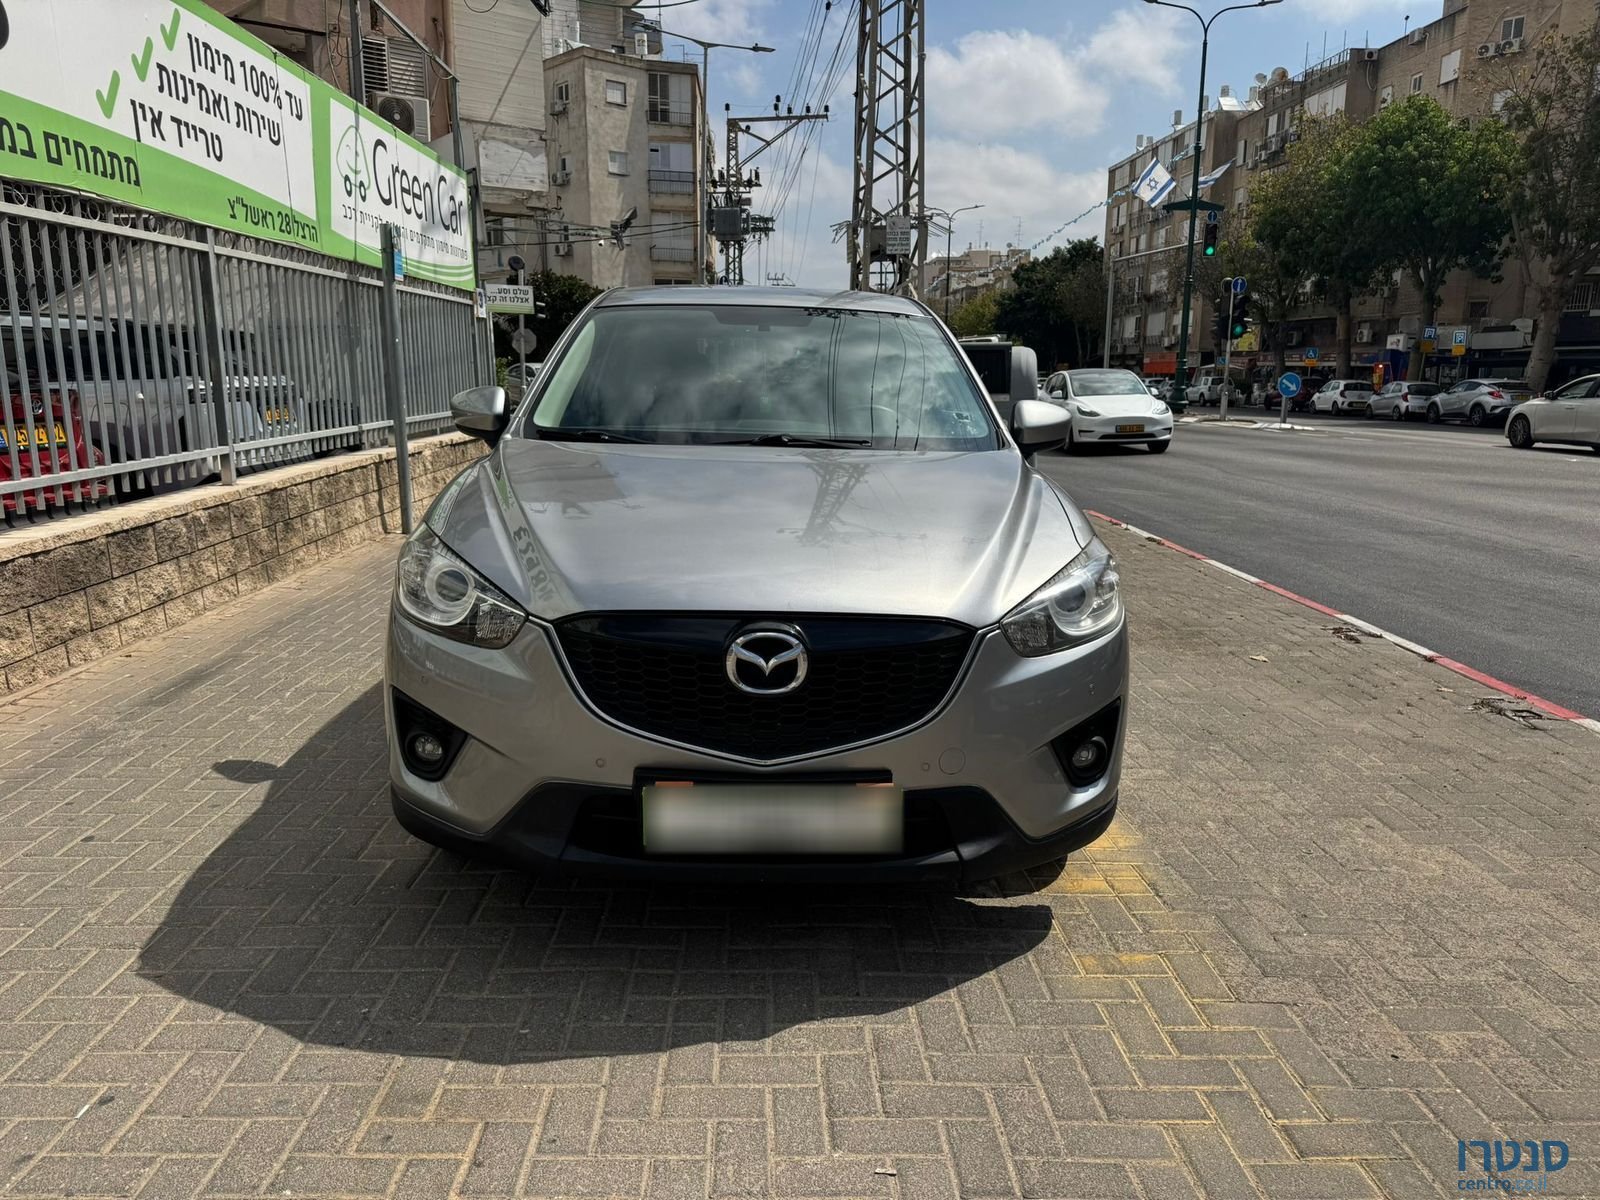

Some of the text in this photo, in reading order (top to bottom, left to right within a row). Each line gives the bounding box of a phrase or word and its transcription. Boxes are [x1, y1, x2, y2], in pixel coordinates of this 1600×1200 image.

[156, 62, 281, 146] שירות ואמינות
[187, 32, 303, 121] עד 100% מימון
[130, 98, 223, 162] טרייד אין
[43, 131, 141, 187] מתמחים
[373, 138, 463, 236] Green Car
[227, 195, 318, 243] הרצל 28 ראשל"צ
[342, 204, 357, 221] רכב
[509, 295, 530, 304] אצלנו
[512, 288, 529, 296] שלם
